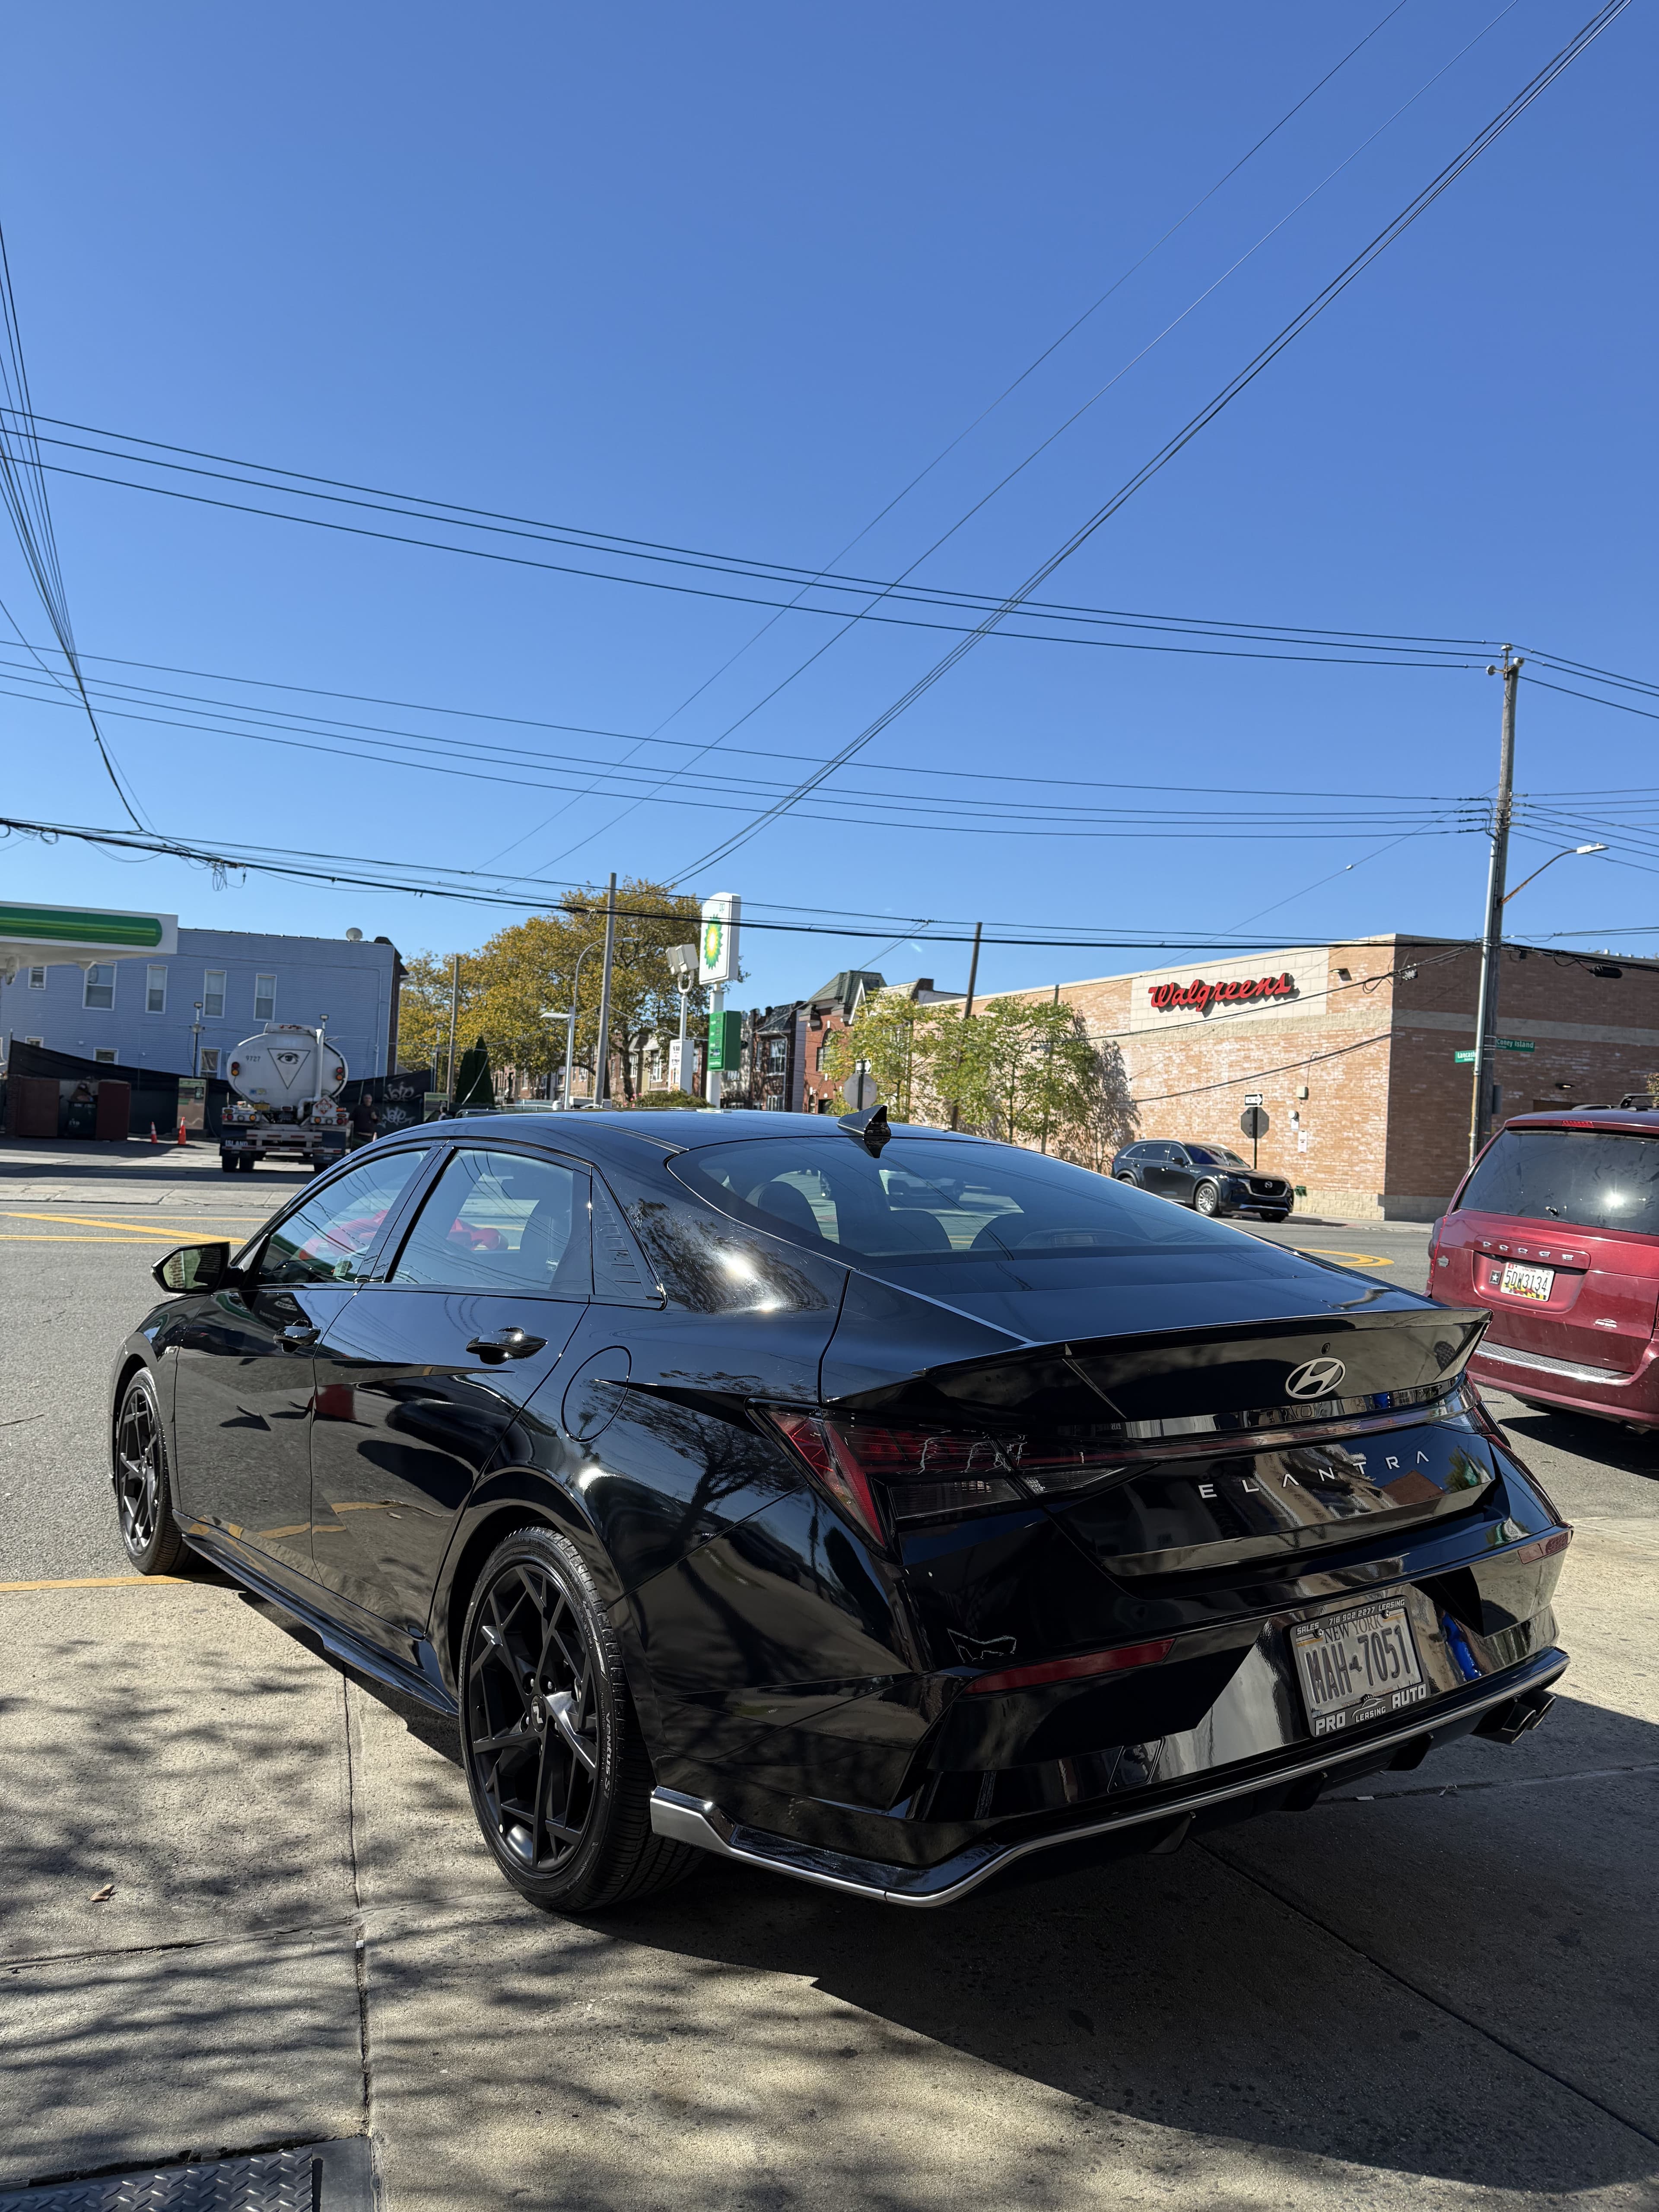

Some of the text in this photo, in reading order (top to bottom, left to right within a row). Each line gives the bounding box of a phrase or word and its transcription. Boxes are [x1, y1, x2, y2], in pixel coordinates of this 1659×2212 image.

[1148, 973, 1291, 1012] Walgreens
[1497, 1039, 1513, 1047] Coney
[1483, 1241, 1574, 1261] DODGE
[1505, 1270, 1548, 1292] 5DW3134
[1198, 1451, 1429, 1499] ELANTRA
[1297, 1599, 1405, 1635] SALES 718 902 2277 LEASING
[1324, 1614, 1383, 1643] NEW YORK
[1316, 1683, 1426, 1736] PRO AUTO
[1355, 1706, 1386, 1723] LEASING
